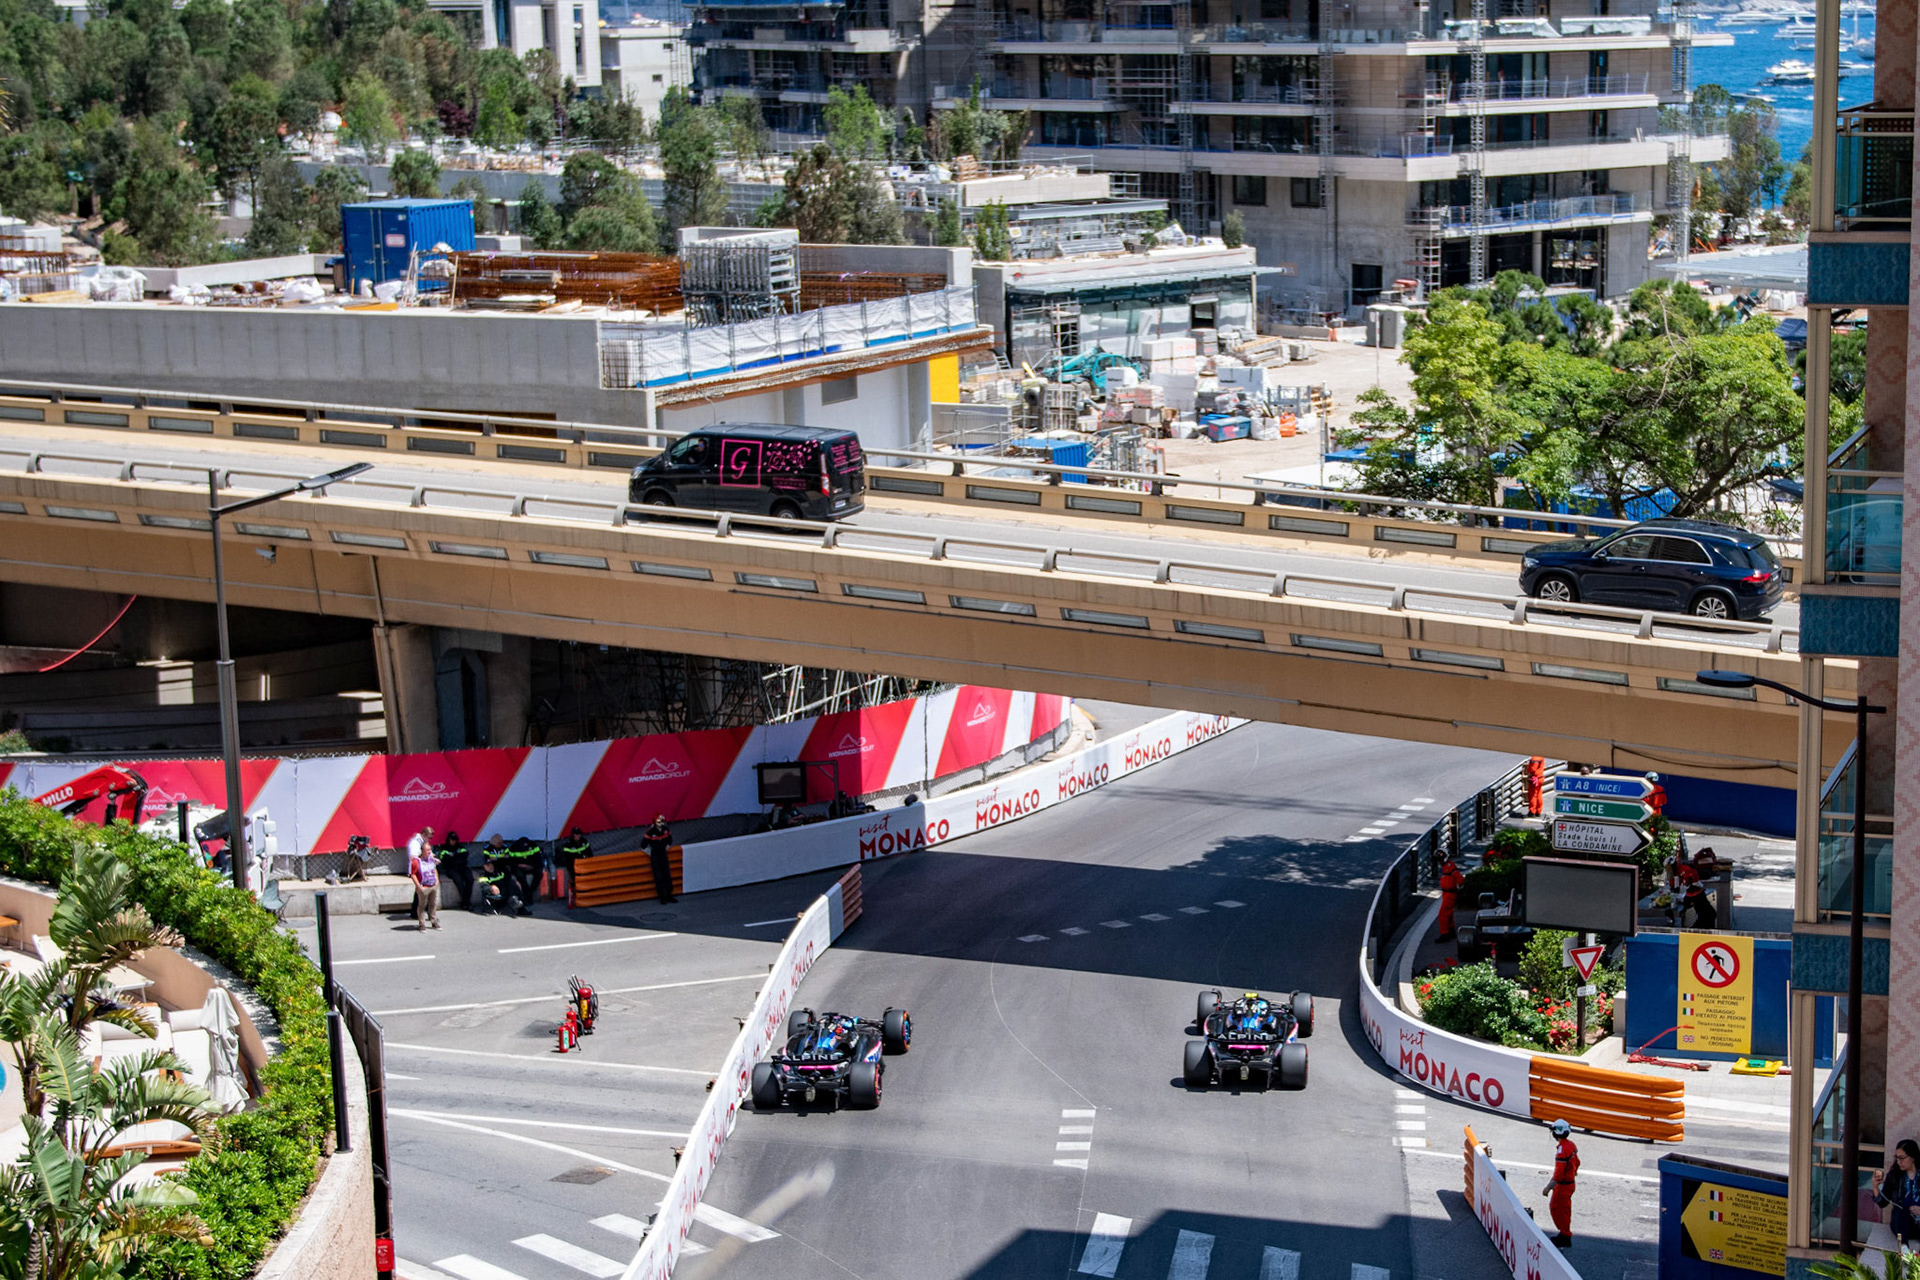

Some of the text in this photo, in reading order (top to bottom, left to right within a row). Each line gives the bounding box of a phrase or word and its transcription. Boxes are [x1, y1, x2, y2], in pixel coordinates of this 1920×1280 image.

[730, 446, 751, 480] G
[1187, 716, 1229, 746] MONACO
[1125, 737, 1171, 771] MONACO
[1058, 763, 1108, 800] MONACO
[1575, 780, 1621, 793] A8 (NICE)
[976, 788, 1040, 830] MONACO
[1578, 802, 1604, 814] NICE
[859, 814, 892, 837] visit
[1558, 832, 1581, 840] Stade
[1584, 834, 1606, 842] Louis
[1568, 824, 1604, 834] HÔPITAL
[860, 818, 950, 860] MONACO
[1572, 841, 1622, 852] CONDAMINE
[1400, 1028, 1428, 1050] visit
[781, 1053, 840, 1061] ALPINE
[1400, 1044, 1504, 1107] MONACO
